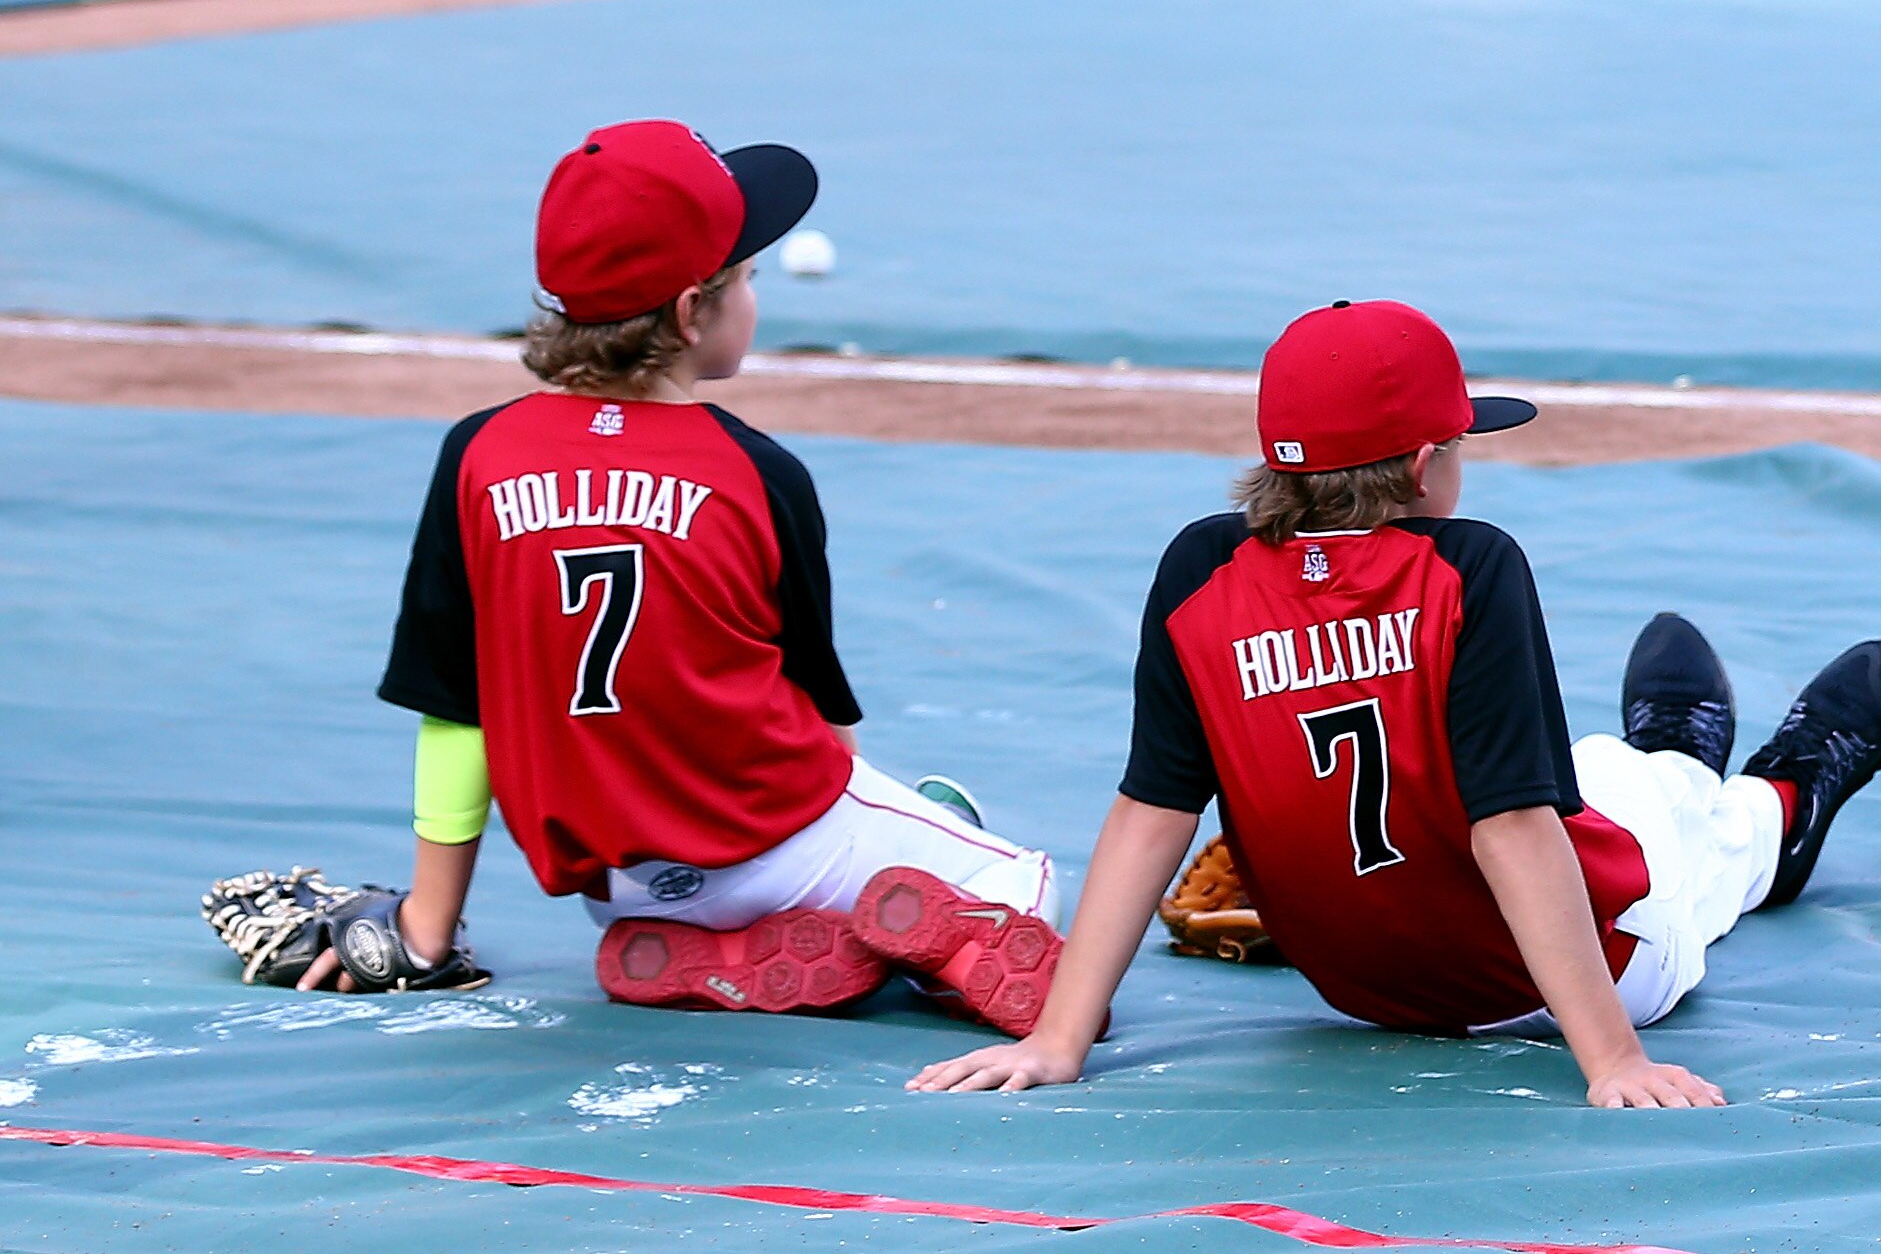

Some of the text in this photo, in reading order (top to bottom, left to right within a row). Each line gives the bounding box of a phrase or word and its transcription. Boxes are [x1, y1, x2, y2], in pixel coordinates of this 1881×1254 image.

[487, 469, 712, 540] HOLLIDAY
[1304, 553, 1328, 571] ASG
[553, 544, 643, 715] 7
[1232, 608, 1419, 700] HOLLIDAY
[1297, 697, 1405, 876] 7
